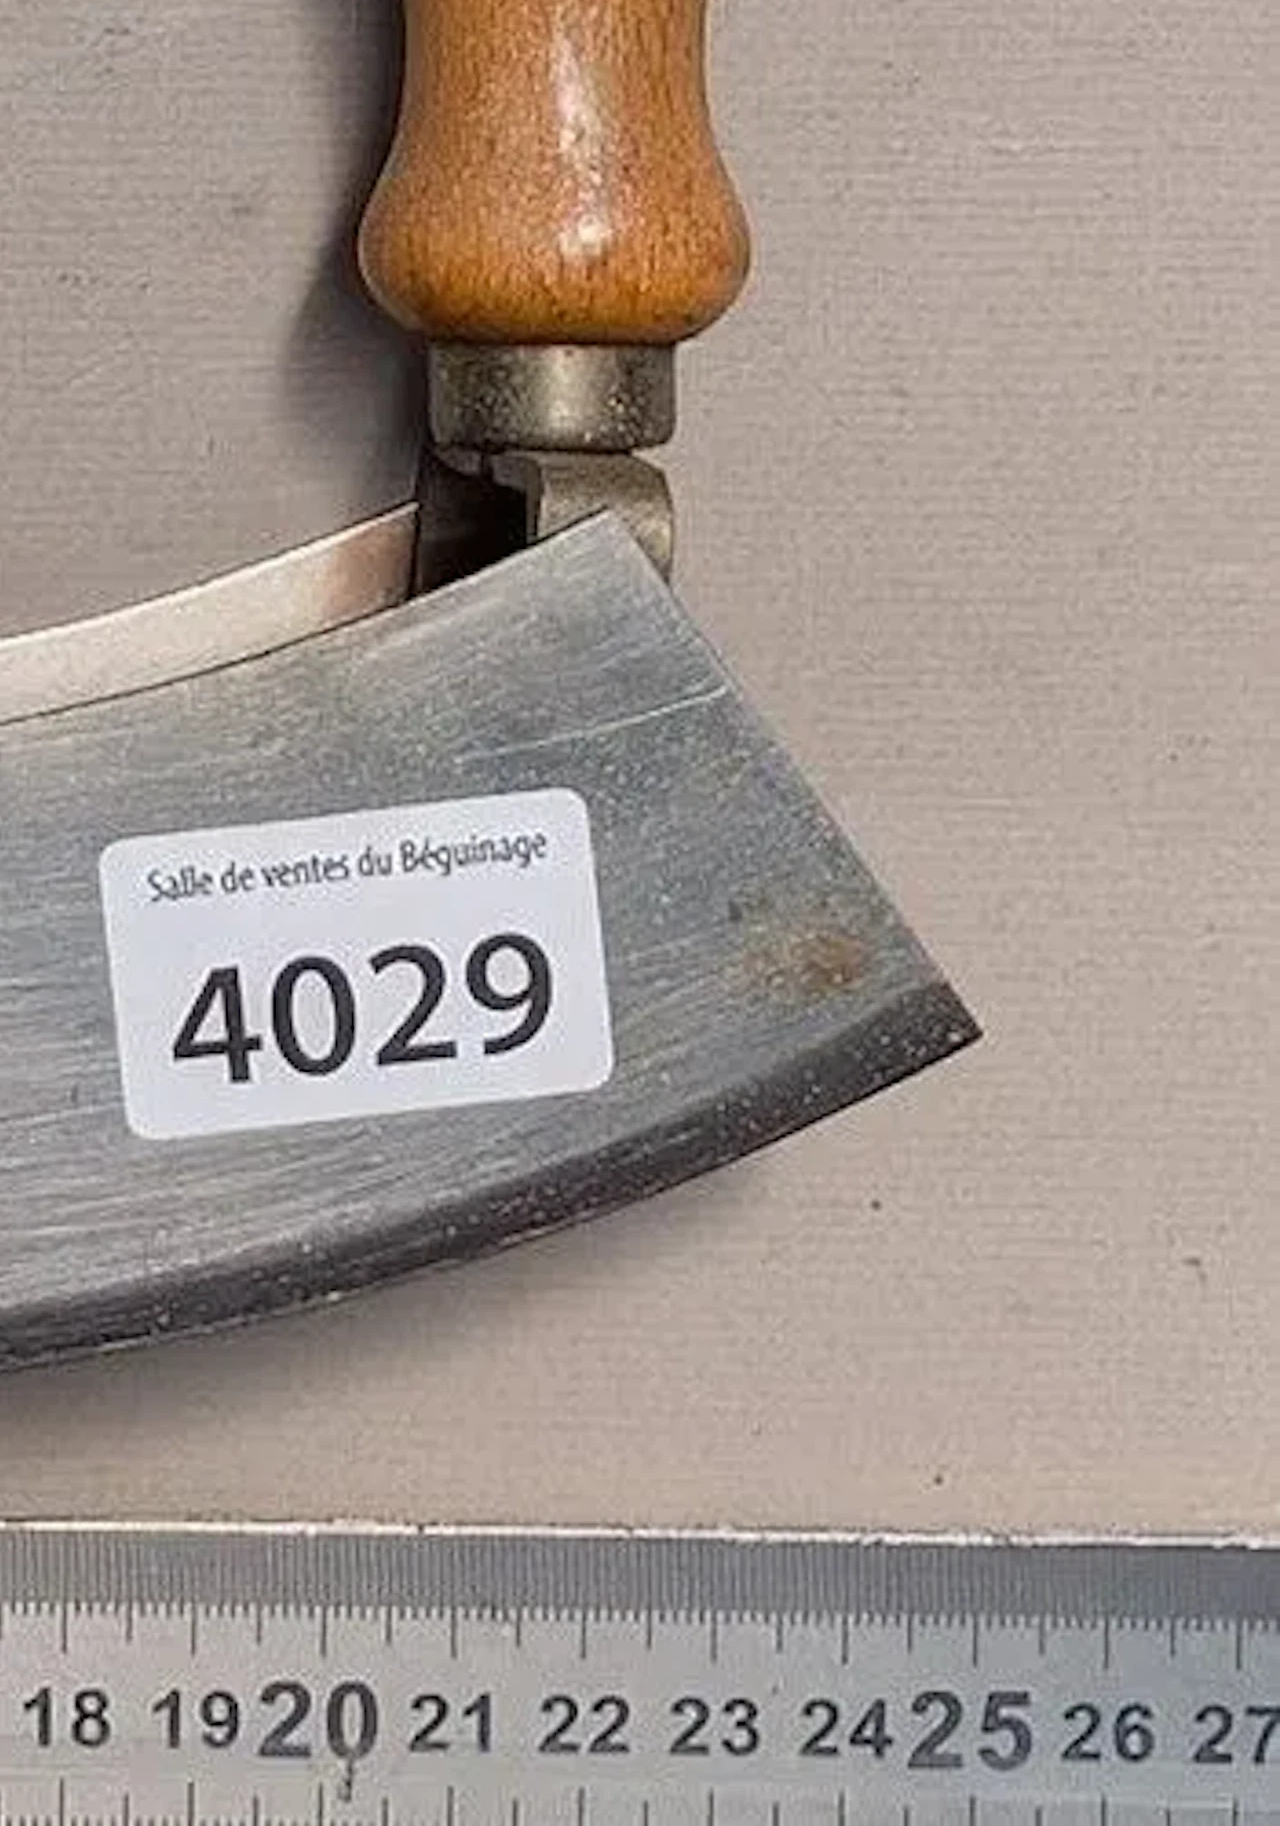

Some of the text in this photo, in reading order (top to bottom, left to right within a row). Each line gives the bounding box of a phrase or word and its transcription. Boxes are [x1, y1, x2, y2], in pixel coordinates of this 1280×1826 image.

[148, 832, 547, 901] Salle de ventes du Béguinage
[172, 931, 553, 1083] 4029
[23, 1687, 110, 1748] 18
[153, 1689, 240, 1749] 19
[258, 1681, 378, 1761] 20
[409, 1693, 491, 1752] 21
[538, 1695, 630, 1753] 22
[669, 1697, 760, 1757] 23
[800, 1699, 894, 1759] 24
[907, 1690, 1033, 1771] 25
[1061, 1703, 1154, 1763] 26
[1192, 1704, 1280, 1765] 27
